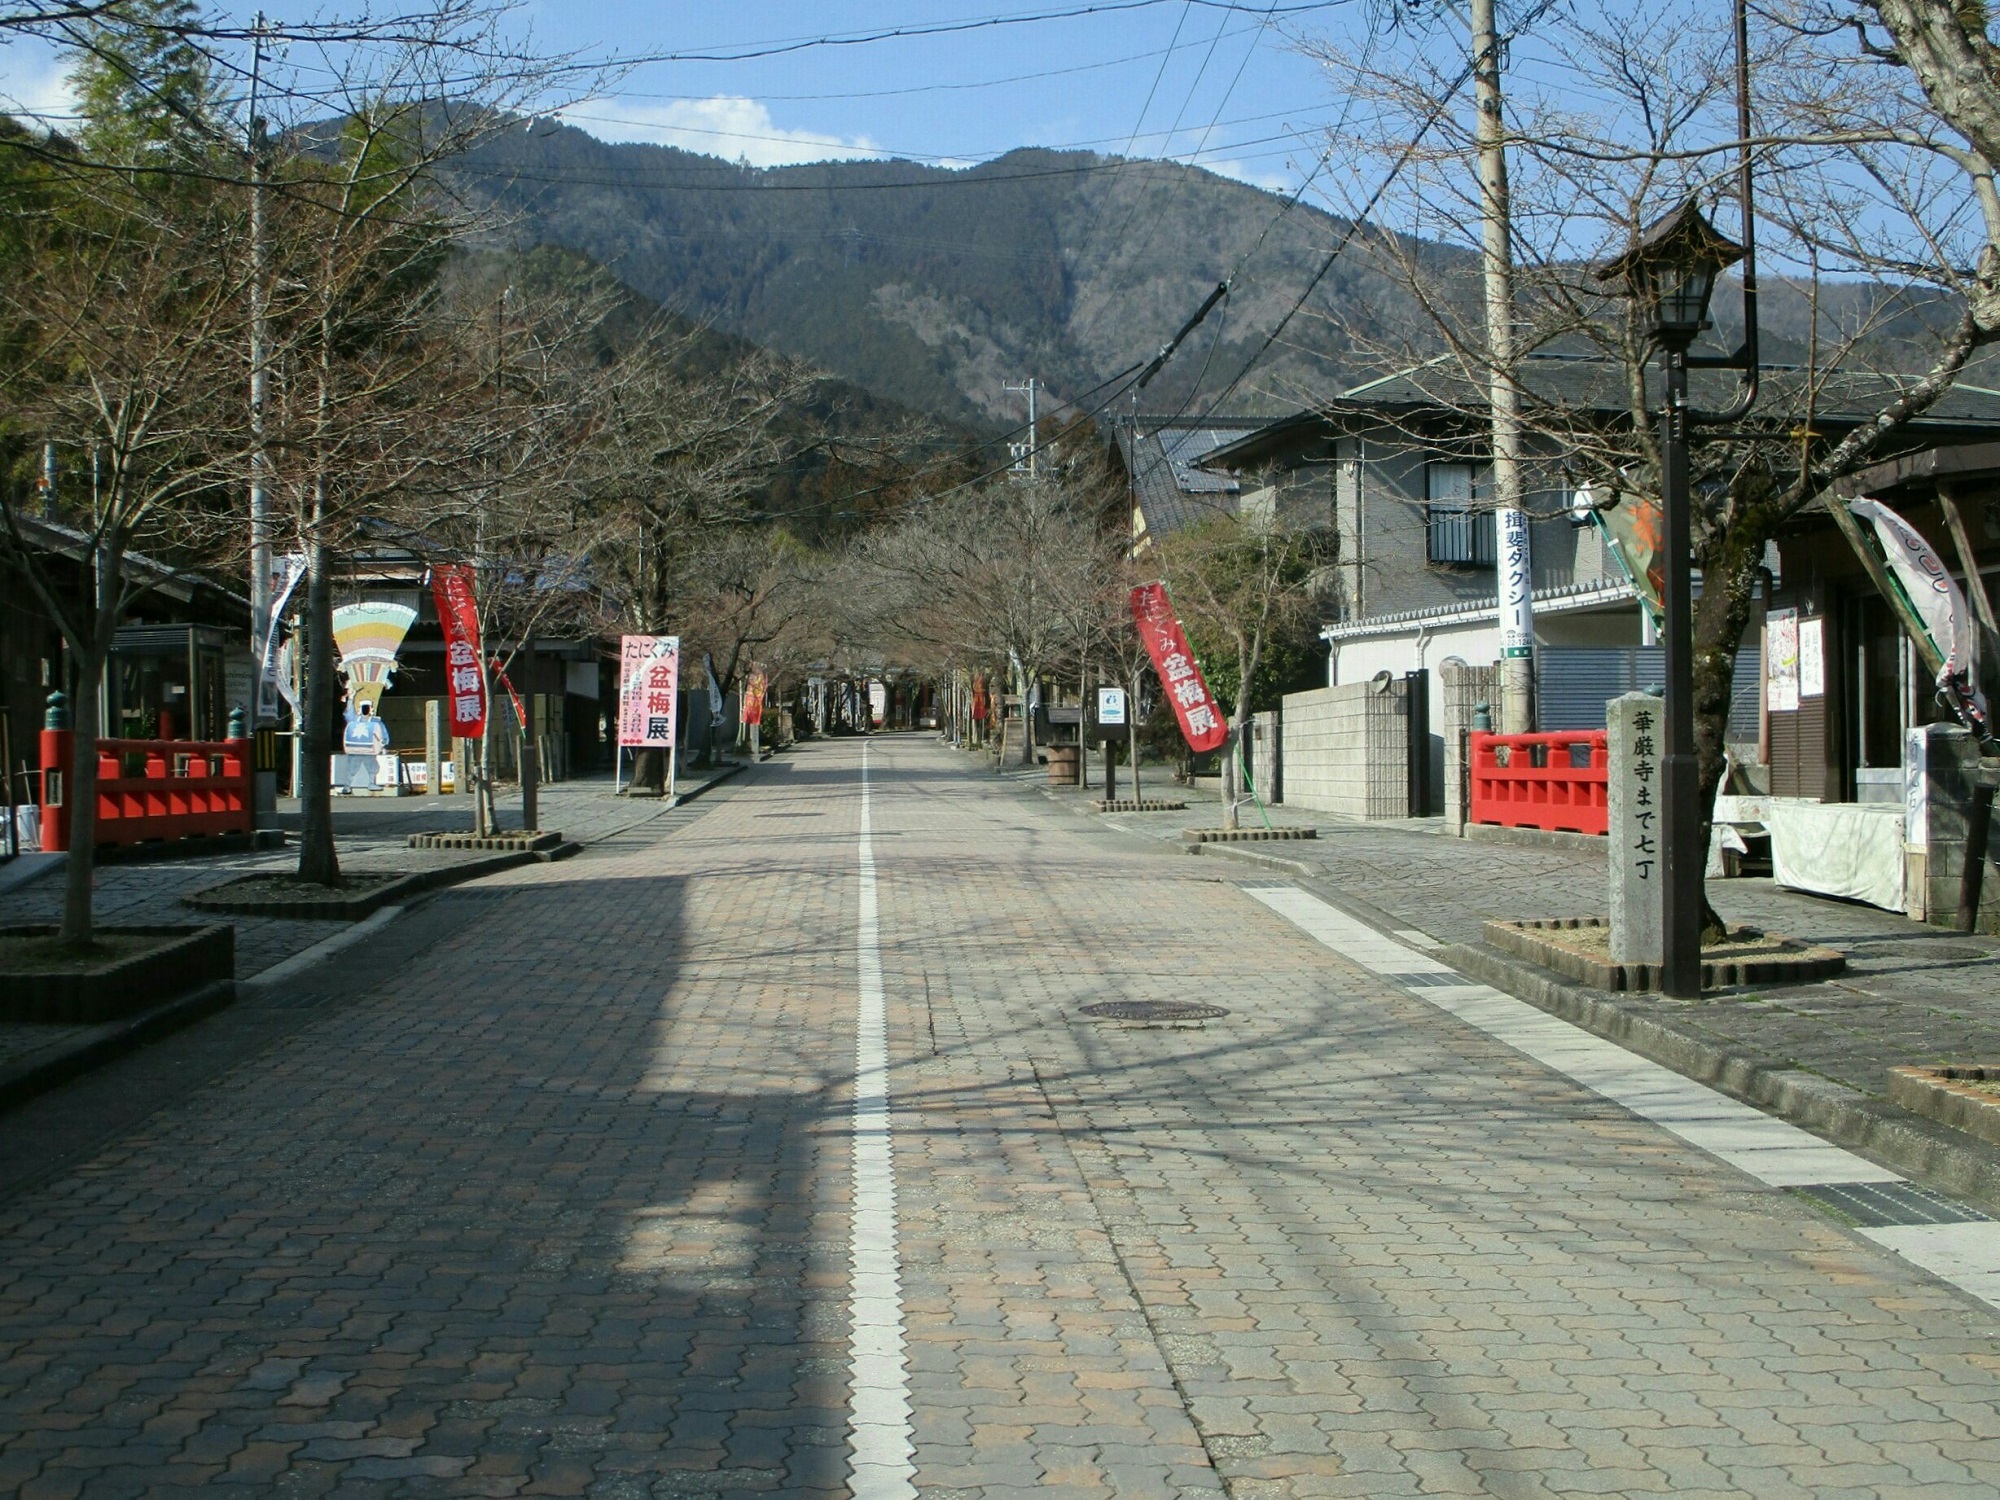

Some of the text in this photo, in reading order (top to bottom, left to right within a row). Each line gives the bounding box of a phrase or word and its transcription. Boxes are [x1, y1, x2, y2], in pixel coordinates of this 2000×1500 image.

[1505, 511, 1525, 626] 揖斐タクシー
[646, 665, 671, 740] 盆梅展
[1632, 711, 1656, 880] 華厳寺まで七丁
